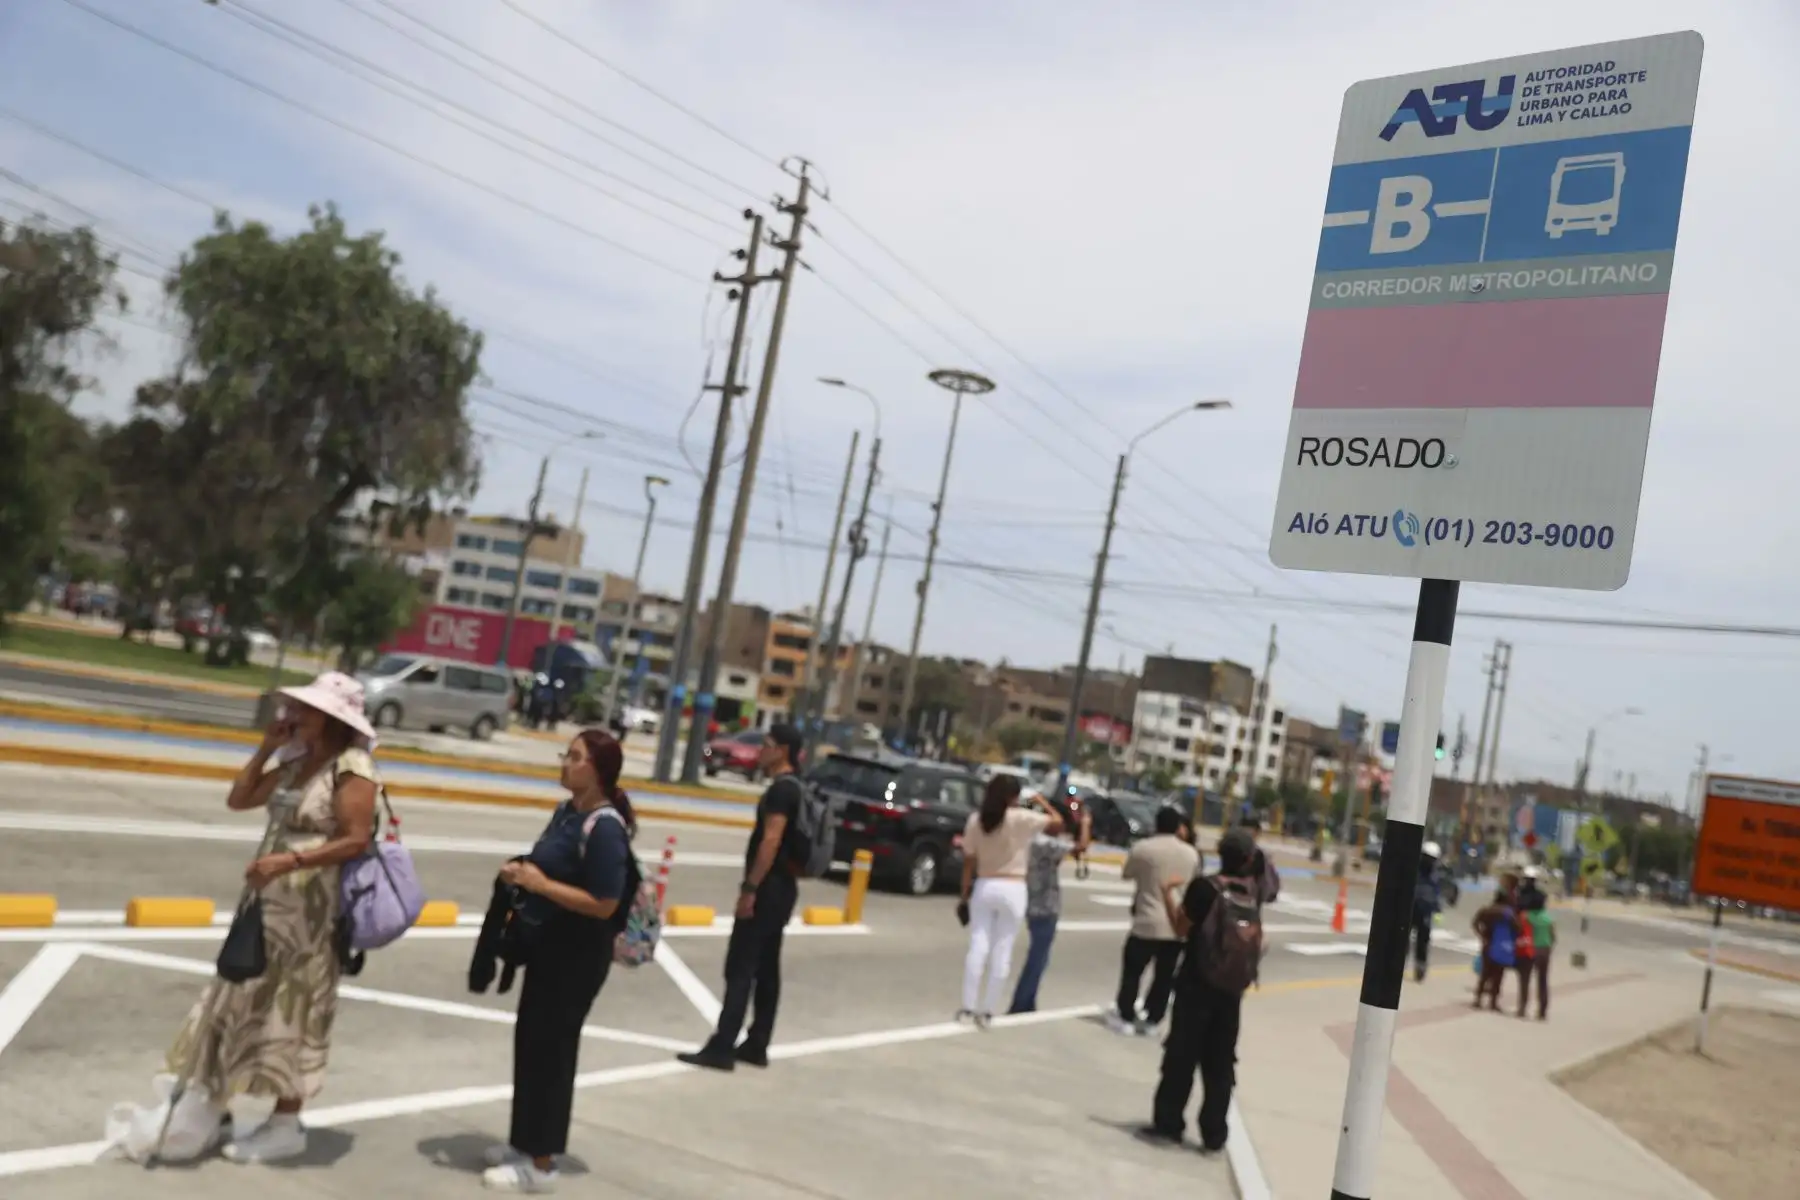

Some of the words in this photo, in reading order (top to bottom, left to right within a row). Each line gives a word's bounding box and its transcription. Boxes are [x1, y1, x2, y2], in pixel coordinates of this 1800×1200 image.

[1521, 86, 1542, 98] DE
[1545, 71, 1647, 94] TRANSPORTE
[1524, 60, 1616, 84] AUTORIDAD
[1378, 74, 1516, 142] ATU
[1517, 110, 1554, 127] LIMA
[1557, 107, 1566, 122] Y
[1570, 102, 1632, 120] CALLAO
[1519, 95, 1584, 112] URBANO
[1587, 88, 1628, 104] PARA
[1368, 175, 1433, 254] B
[1321, 275, 1442, 299] CORREDOR
[1297, 436, 1446, 469] ROSADO
[1287, 511, 1330, 535] Aló
[1334, 514, 1388, 538] ATU
[1424, 517, 1474, 548] (01)
[1482, 520, 1615, 550] 203-9000
[425, 613, 482, 650] ONE
